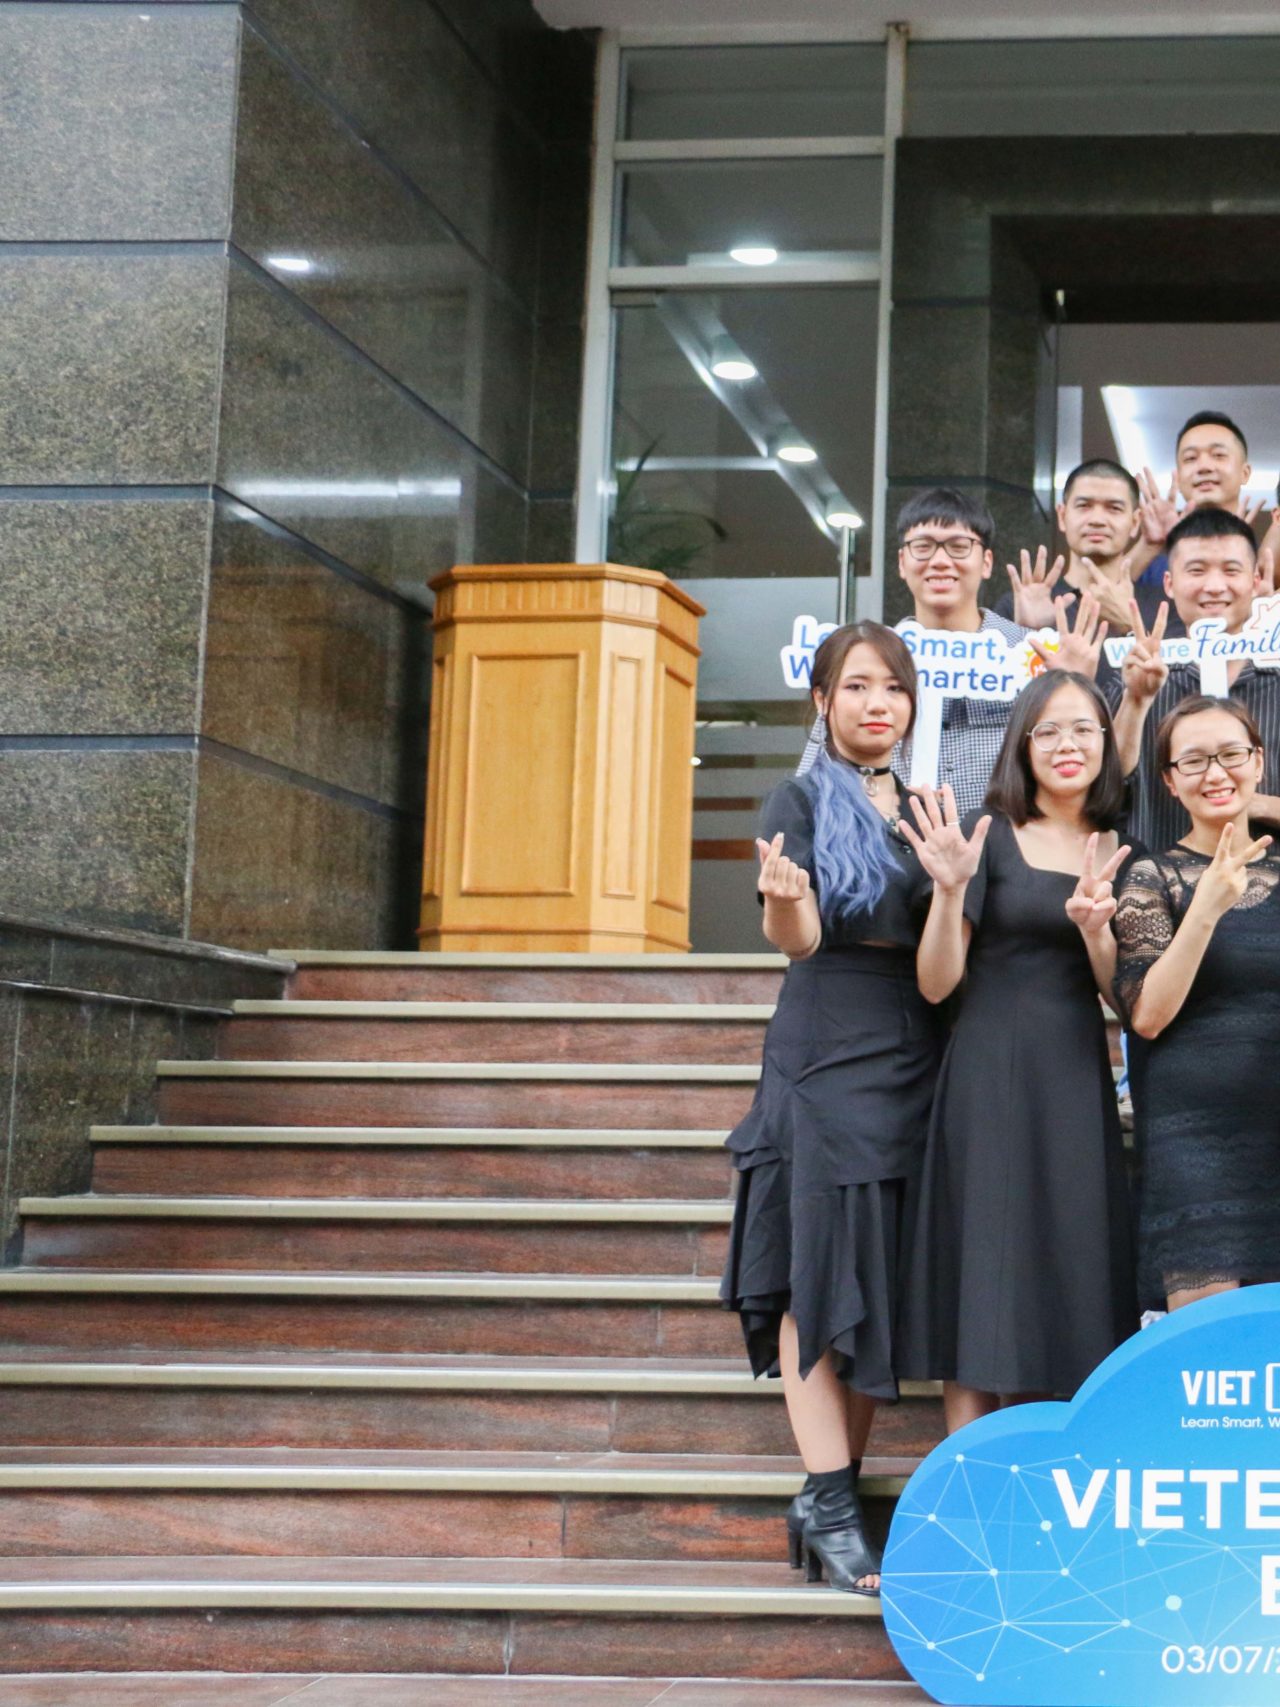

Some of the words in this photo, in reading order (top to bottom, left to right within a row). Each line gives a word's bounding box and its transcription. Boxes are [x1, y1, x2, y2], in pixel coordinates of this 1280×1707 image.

[902, 630, 1006, 664] Smart,
[1181, 1370, 1256, 1406] VIET
[1181, 1416, 1219, 1428] Learn
